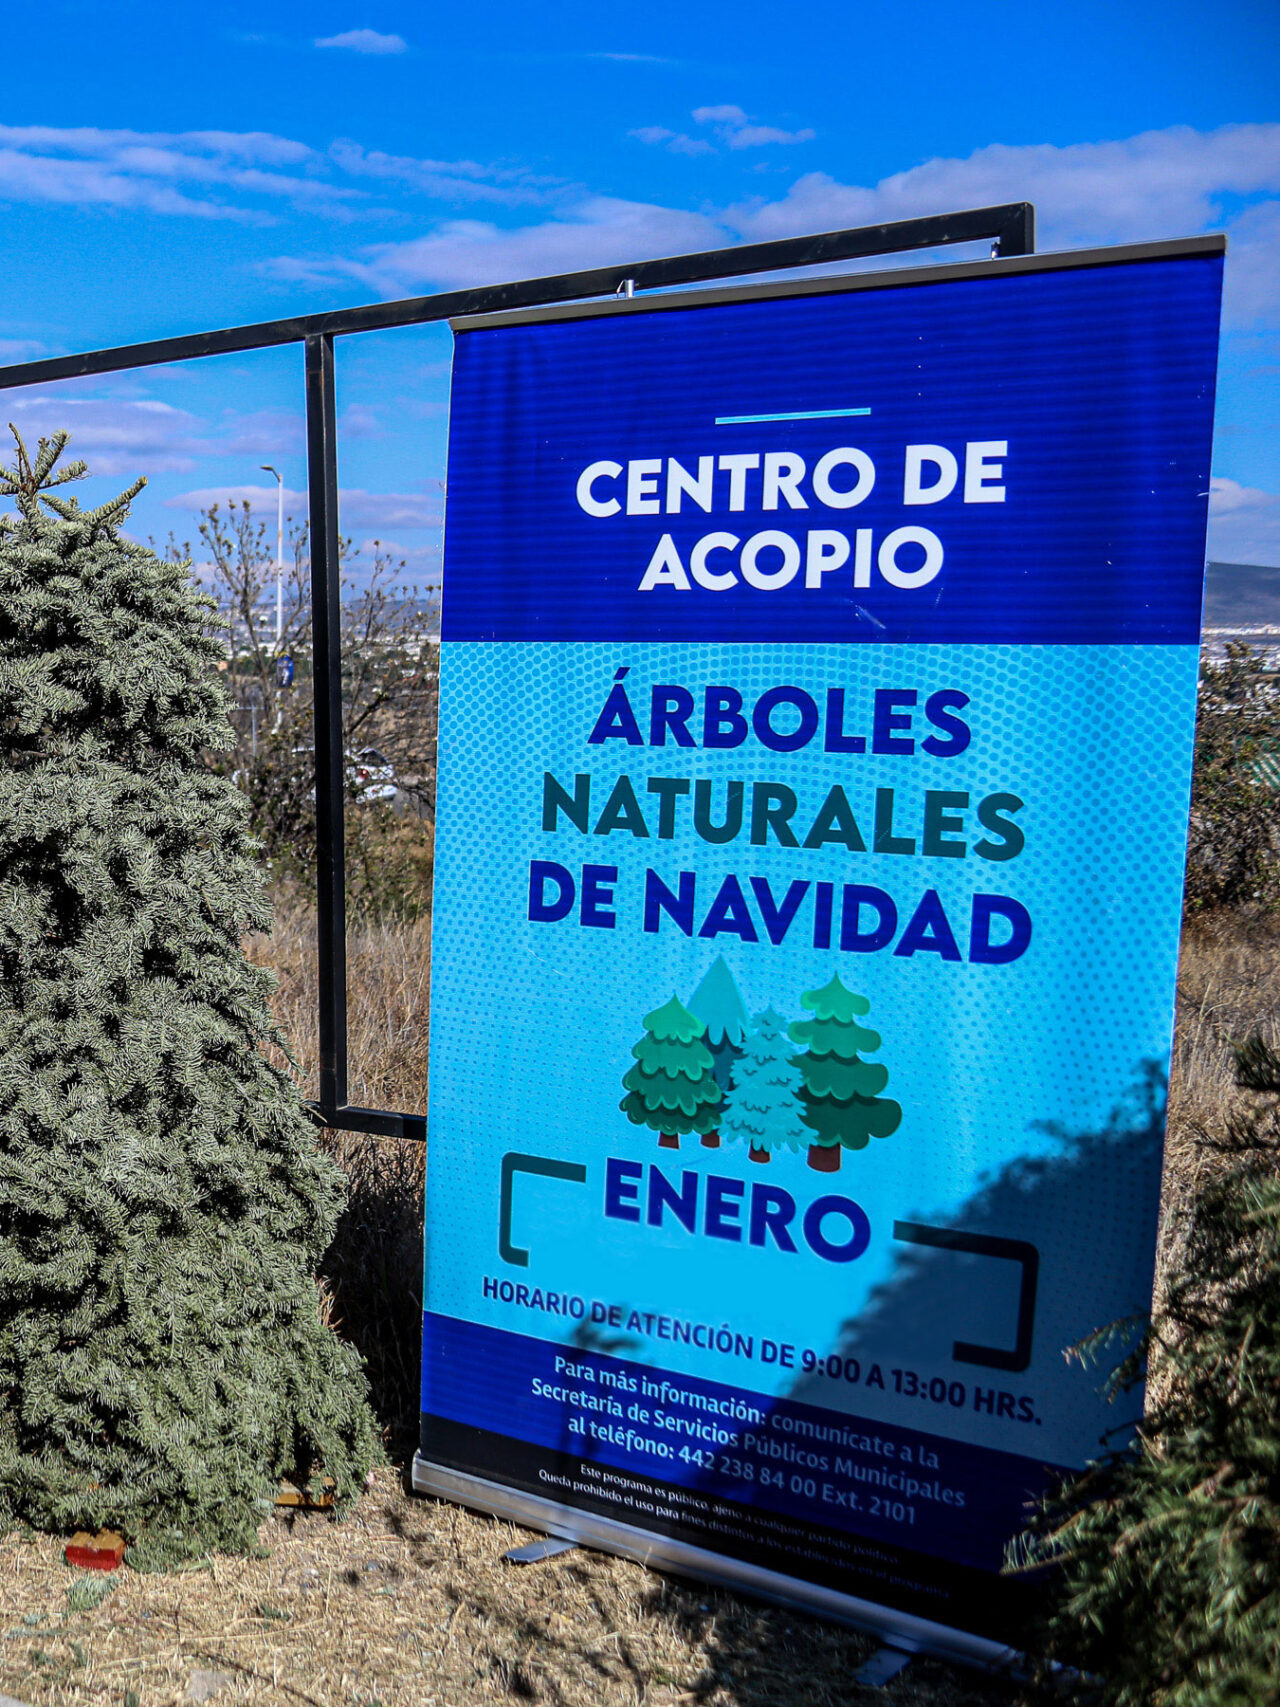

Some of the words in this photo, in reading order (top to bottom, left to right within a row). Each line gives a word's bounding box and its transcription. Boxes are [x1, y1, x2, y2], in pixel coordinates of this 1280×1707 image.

[576, 446, 876, 518] CENTRO
[904, 440, 1009, 505] DE
[638, 526, 945, 591] ACOPIO
[587, 667, 972, 757] ÁRBOLES
[542, 771, 1026, 862] NATURALES
[528, 860, 619, 929] DE
[643, 868, 1033, 964] NAVIDAD
[605, 1156, 871, 1263] ENERO
[483, 1276, 585, 1319] HORARIO
[591, 1301, 622, 1328] DE
[626, 1310, 753, 1358] ATENCIÓN
[760, 1340, 794, 1368] DE
[801, 1349, 860, 1384] 9:00
[865, 1364, 885, 1390] A
[891, 1369, 966, 1407] 13:00
[973, 1386, 1042, 1426] HRS.
[531, 1378, 623, 1417] Secretaría
[627, 1403, 650, 1424] de
[654, 1410, 738, 1448] Servicios
[744, 1432, 829, 1471] Públicos
[834, 1456, 966, 1508] Municipales
[554, 1355, 595, 1383] Para
[599, 1371, 637, 1393] más
[641, 1376, 767, 1425] información:
[772, 1413, 895, 1456] comunícate
[900, 1446, 913, 1463] a
[919, 1445, 940, 1469] la
[539, 1469, 572, 1488] Queda
[573, 1481, 622, 1502] prohibido
[624, 1495, 634, 1507] el
[635, 1499, 654, 1513] uso
[656, 1505, 680, 1521] para
[681, 1510, 706, 1528] fines
[568, 1415, 586, 1436] al
[589, 1419, 674, 1460] teléfono:
[678, 1445, 715, 1470] 442
[720, 1455, 754, 1481] 238
[759, 1466, 785, 1490] 84
[790, 1475, 816, 1498] 00
[822, 1482, 864, 1512] Ext.
[869, 1496, 916, 1525] 2101
[580, 1464, 601, 1480] Este
[603, 1472, 653, 1495] programa
[654, 1487, 666, 1498] es
[712, 1503, 743, 1520] ajeno
